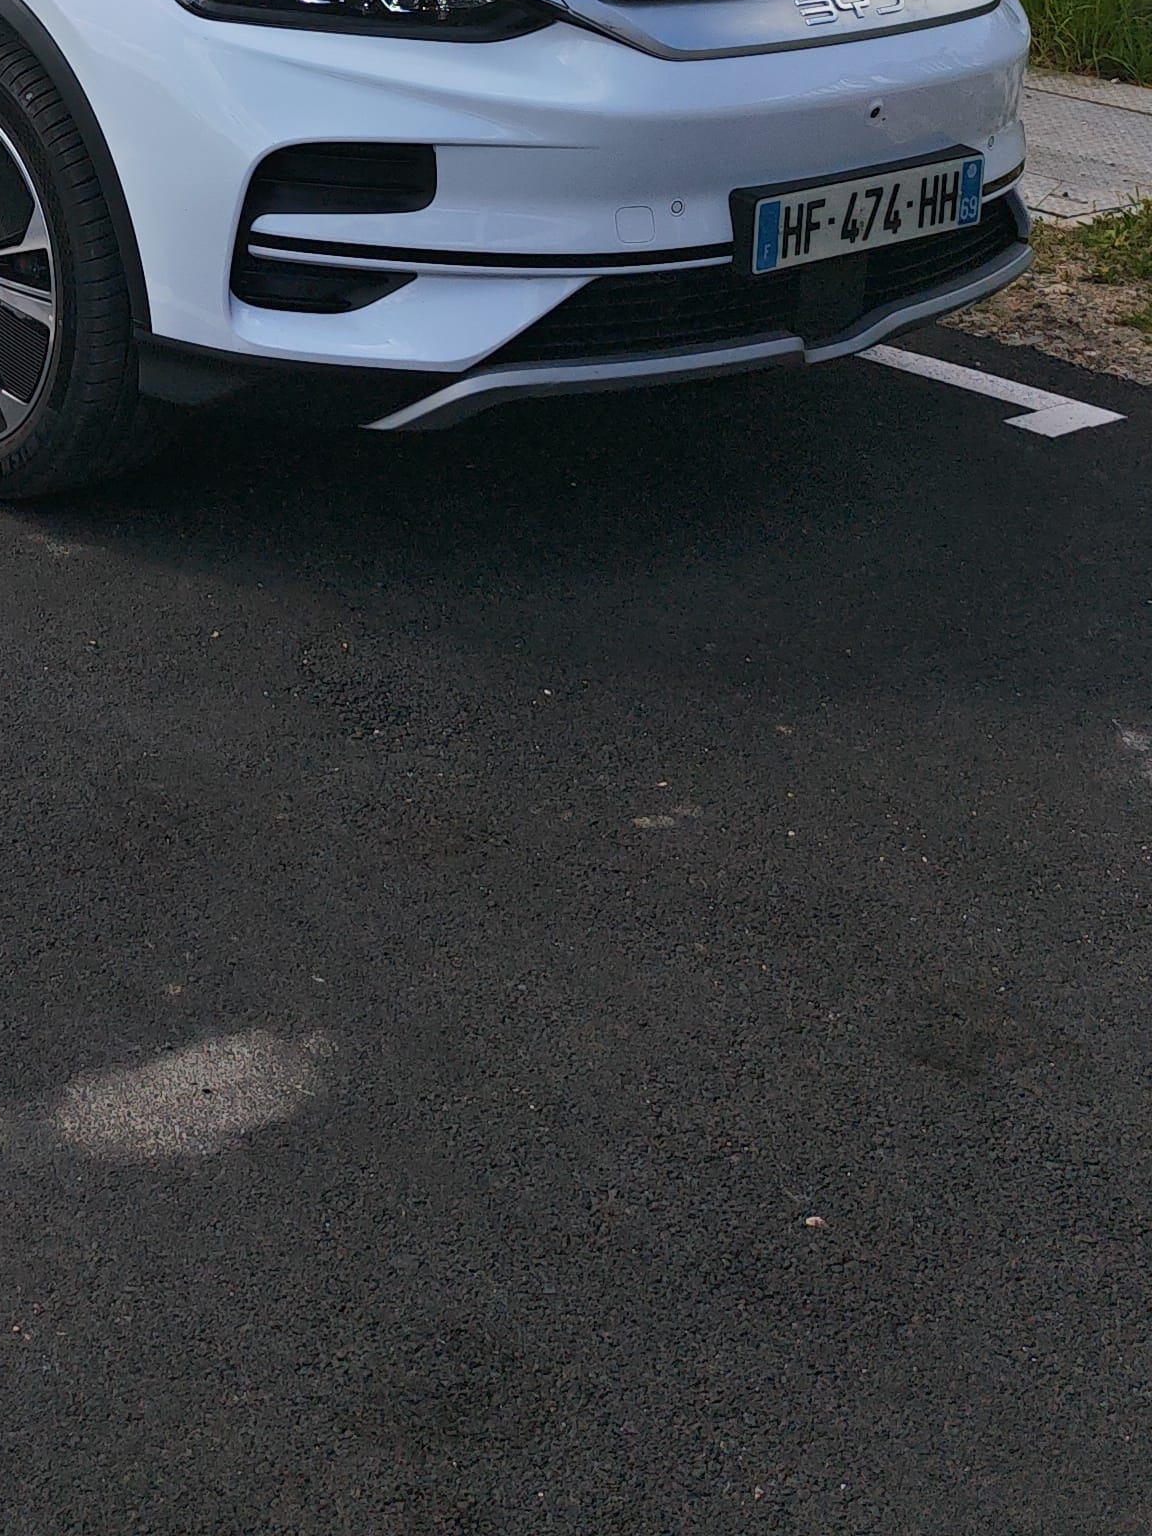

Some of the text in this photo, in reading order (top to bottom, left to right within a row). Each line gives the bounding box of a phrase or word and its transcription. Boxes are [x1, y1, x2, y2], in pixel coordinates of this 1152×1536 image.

[781, 171, 959, 259] HF-474-HH
[960, 195, 978, 220] 69
[763, 243, 772, 260] F
